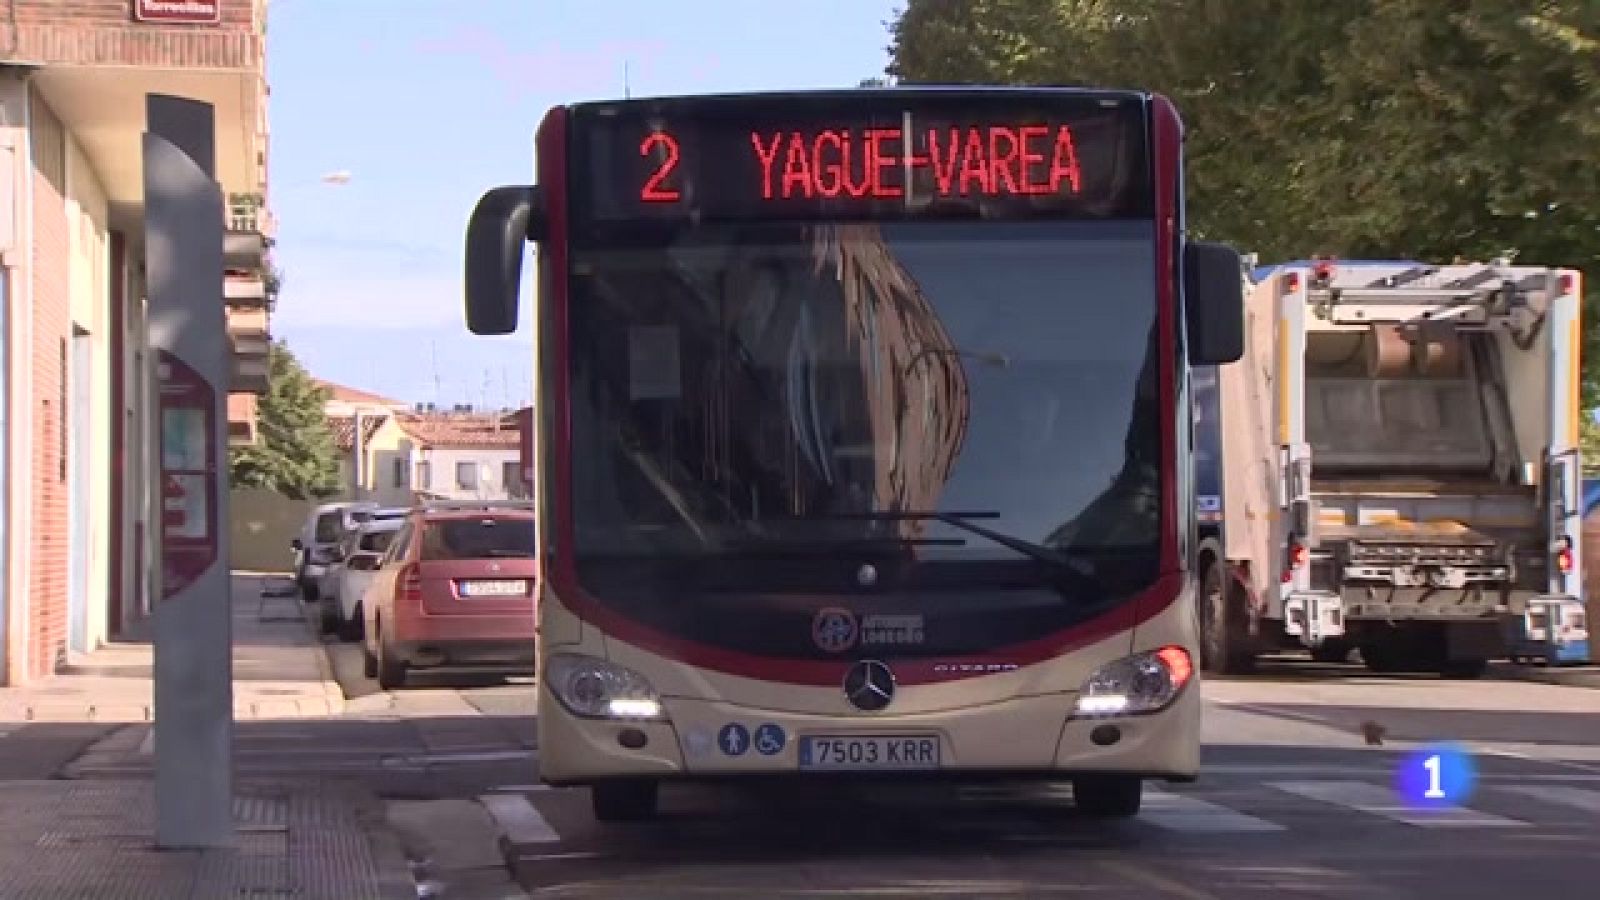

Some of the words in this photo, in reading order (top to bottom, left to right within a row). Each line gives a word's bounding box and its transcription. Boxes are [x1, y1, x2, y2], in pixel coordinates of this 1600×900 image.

[639, 132, 681, 201] 2
[817, 740, 878, 763] 7503
[887, 739, 933, 762] KRR
